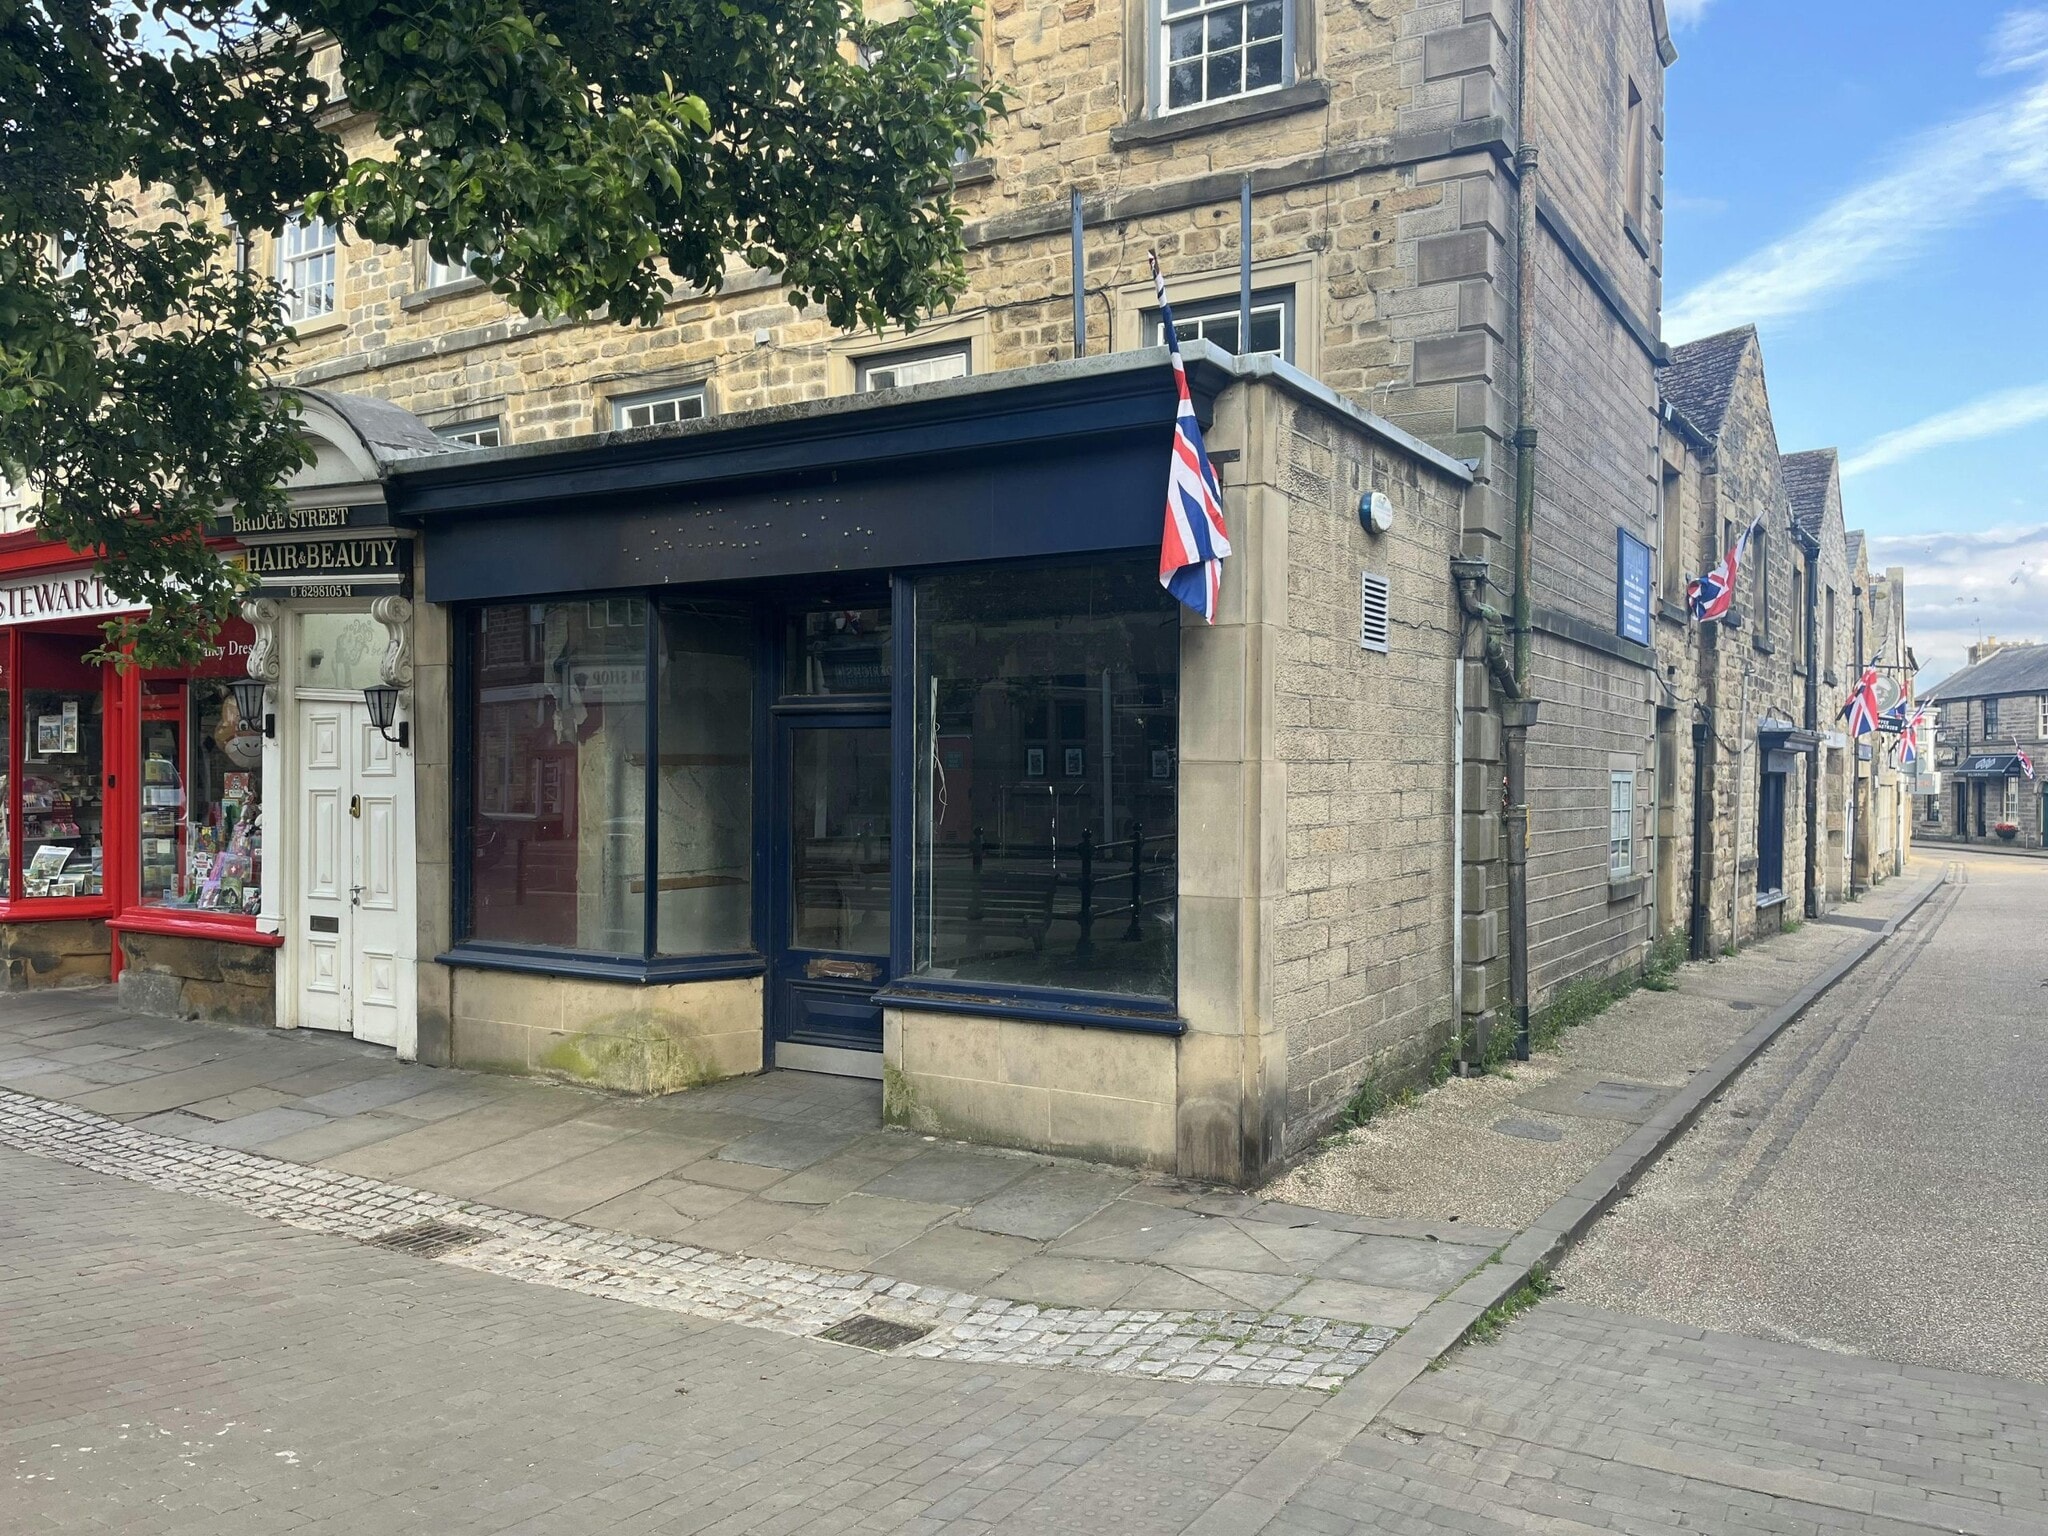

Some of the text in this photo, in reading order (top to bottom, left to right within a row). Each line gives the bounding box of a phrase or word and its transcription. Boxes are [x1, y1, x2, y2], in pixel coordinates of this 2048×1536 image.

[232, 506, 349, 533] BRIDGE STREET
[202, 640, 253, 661] ancy Dres
